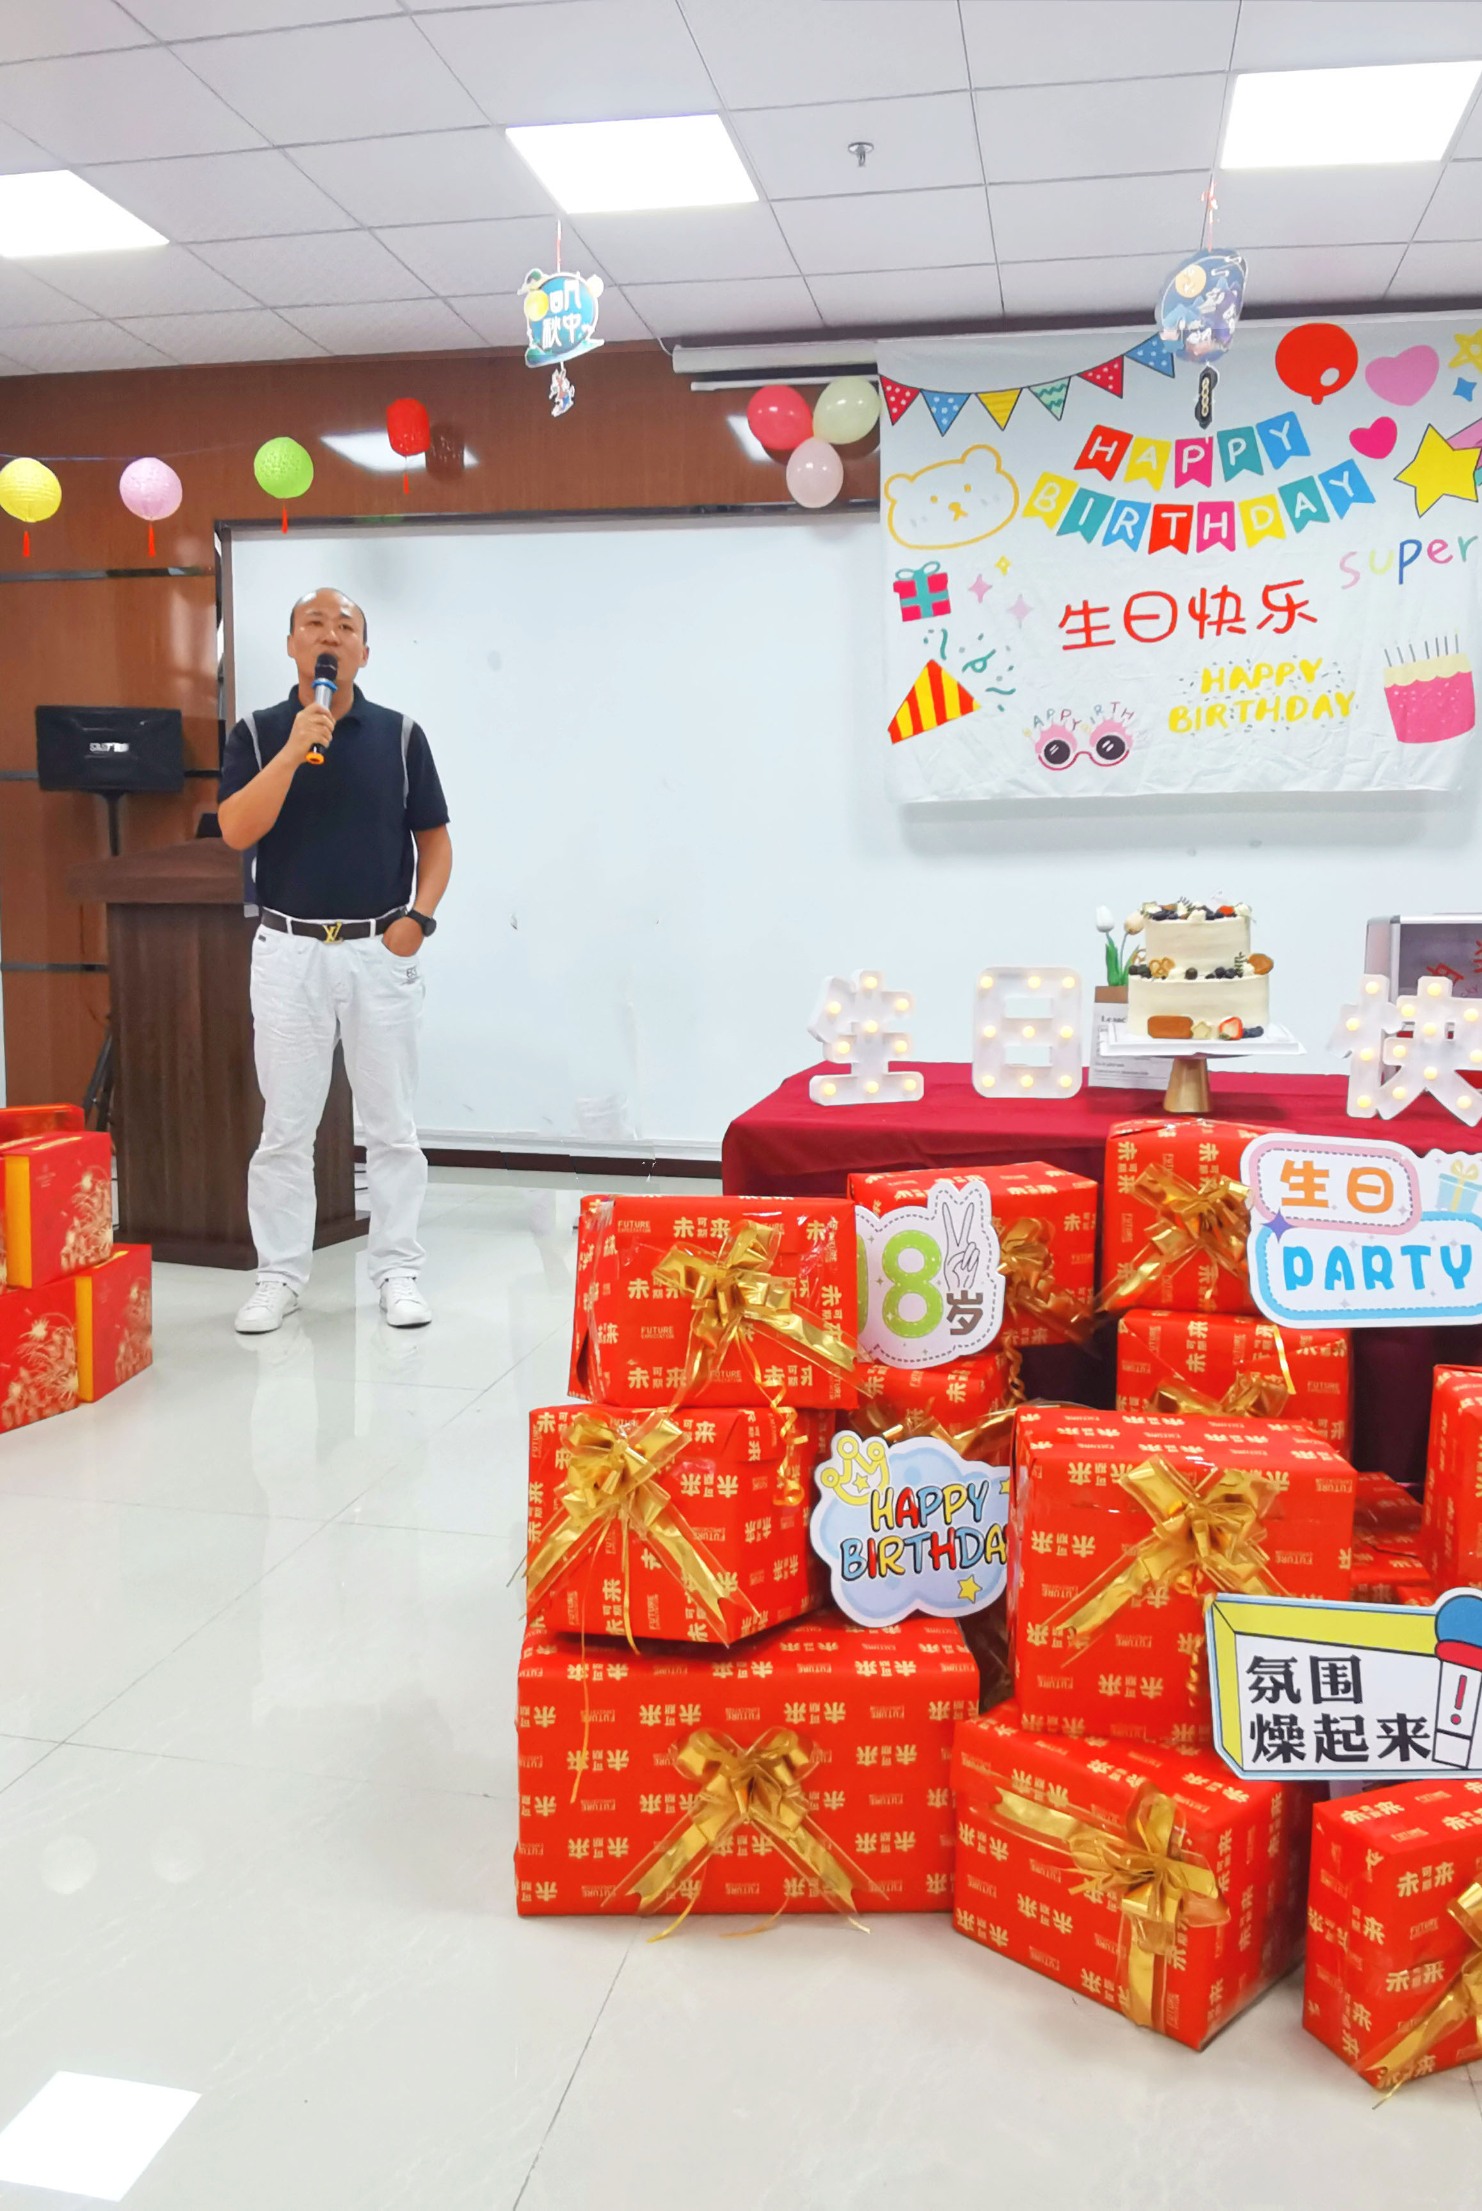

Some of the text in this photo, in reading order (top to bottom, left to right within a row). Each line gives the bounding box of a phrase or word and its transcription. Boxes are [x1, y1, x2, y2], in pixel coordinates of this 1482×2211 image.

[1088, 421, 1293, 478] HAPPY
[1034, 471, 1356, 546] BIRTHDAY
[1058, 579, 1318, 651] 生日快乐
[1200, 656, 1324, 694] HAPPY
[1167, 692, 1356, 735] BIRTHDAY
[1280, 1158, 1394, 1214] 生日
[617, 1220, 651, 1228] FUTURE
[1282, 1244, 1473, 1291] PARTY
[641, 1326, 674, 1334] FUTURE
[870, 1480, 990, 1532] HAPPY
[839, 1522, 1008, 1582] BIRTHDA
[1246, 1655, 1363, 1705] 氛围
[1249, 1712, 1431, 1764] 燥起来
